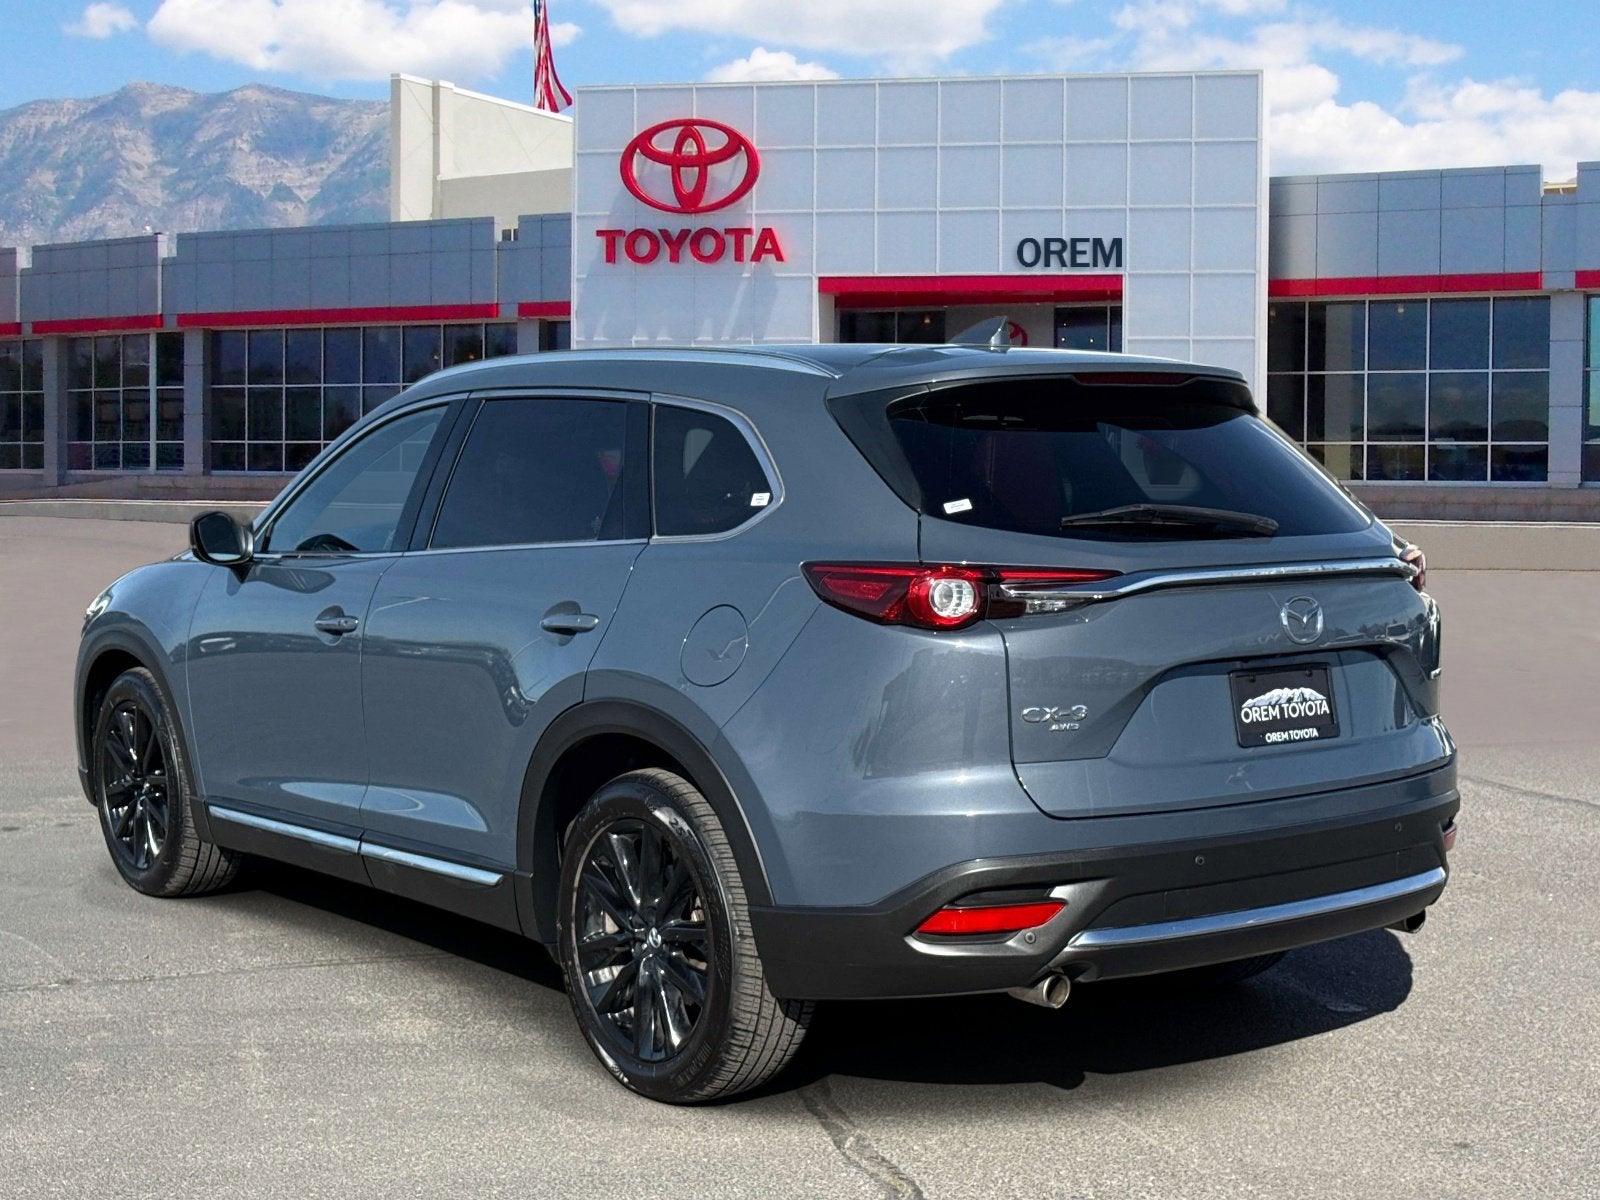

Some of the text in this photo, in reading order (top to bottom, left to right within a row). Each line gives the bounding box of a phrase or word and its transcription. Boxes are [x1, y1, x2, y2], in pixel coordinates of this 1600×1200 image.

[596, 227, 785, 264] TOYOTA
[1017, 237, 1123, 268] OREM
[1241, 700, 1330, 723] OREM TOYOTA
[1265, 727, 1319, 743] OREM TOYOTA
